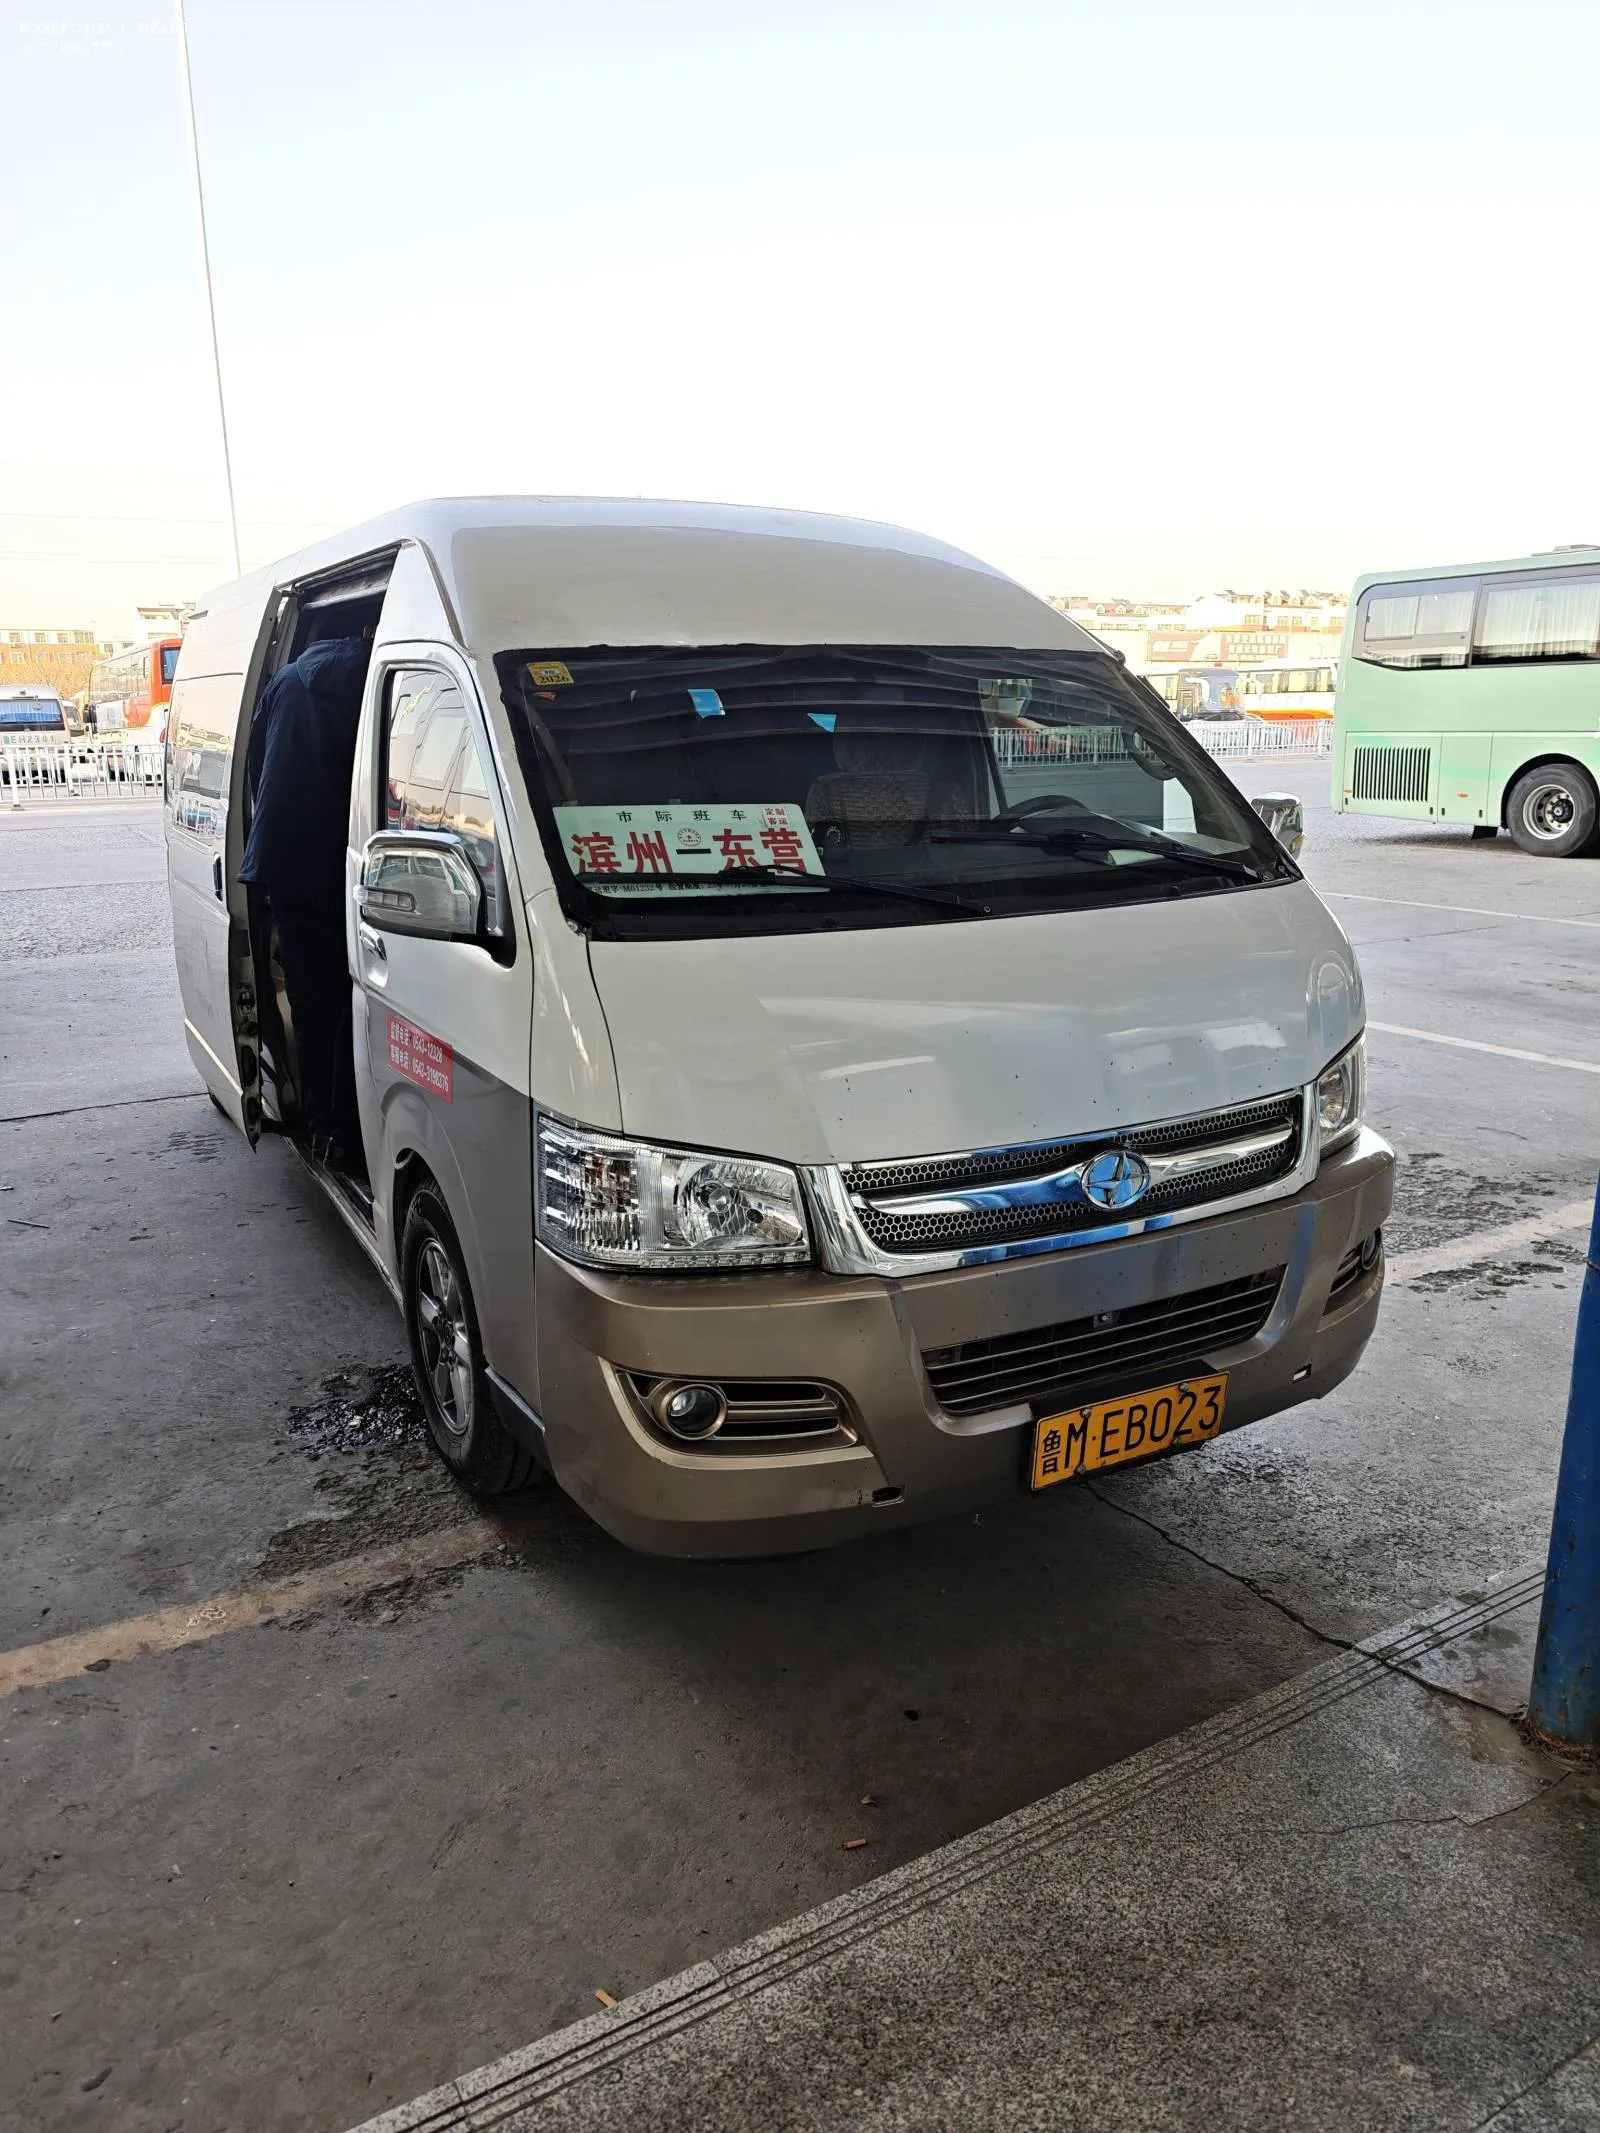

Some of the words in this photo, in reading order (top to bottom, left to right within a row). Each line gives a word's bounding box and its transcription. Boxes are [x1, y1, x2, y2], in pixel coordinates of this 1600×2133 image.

[539, 675, 570, 684] 2026
[616, 809, 748, 823] 市际班车
[765, 808, 785, 816] 定制
[768, 817, 788, 825] 客运
